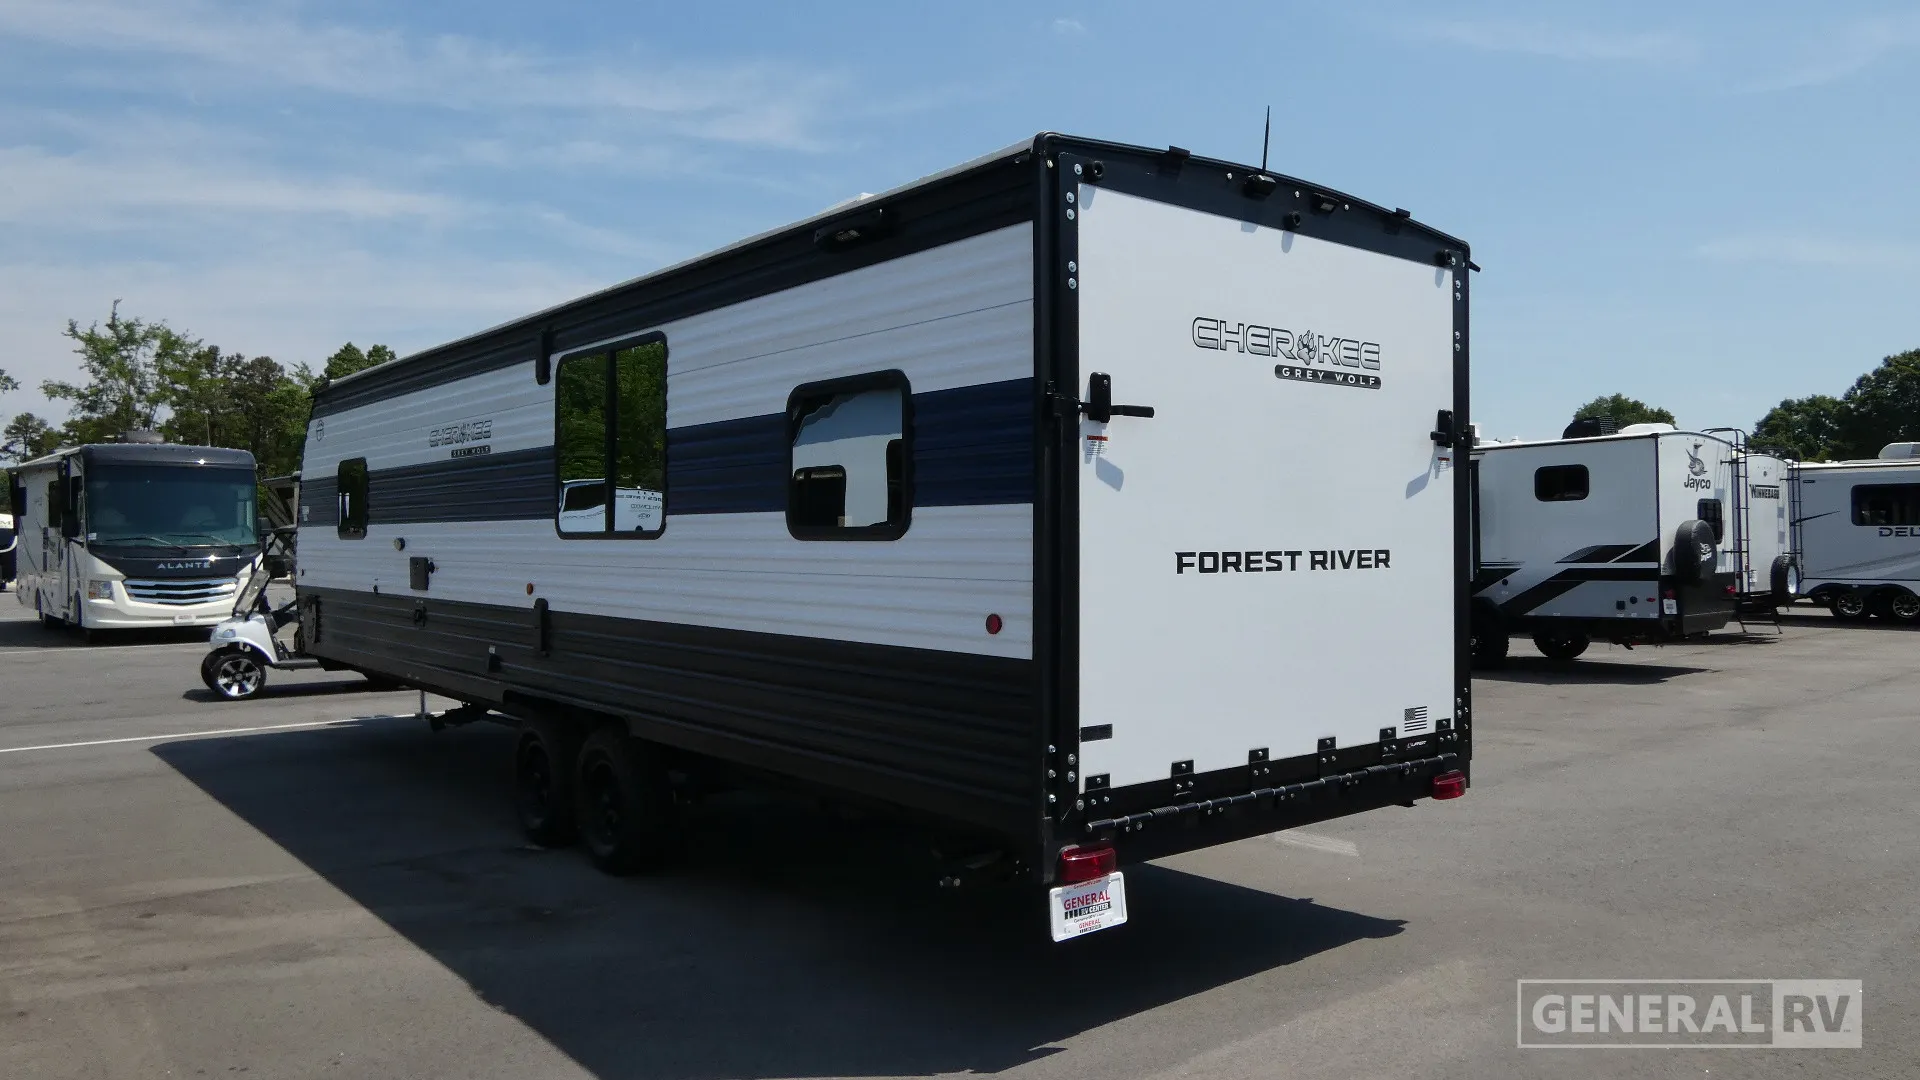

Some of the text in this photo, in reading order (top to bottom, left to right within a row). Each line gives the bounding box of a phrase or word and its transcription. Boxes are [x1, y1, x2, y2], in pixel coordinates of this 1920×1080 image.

[1282, 367, 1375, 386] GREY WOLF
[1684, 474, 1711, 492] Jayco
[1749, 484, 1779, 499] WINNEBAGO
[1878, 526, 1920, 537] DEL
[1174, 549, 1391, 575] FOREST RIVER
[1063, 889, 1111, 910] GENERAL
[1090, 902, 1109, 913] CENTER
